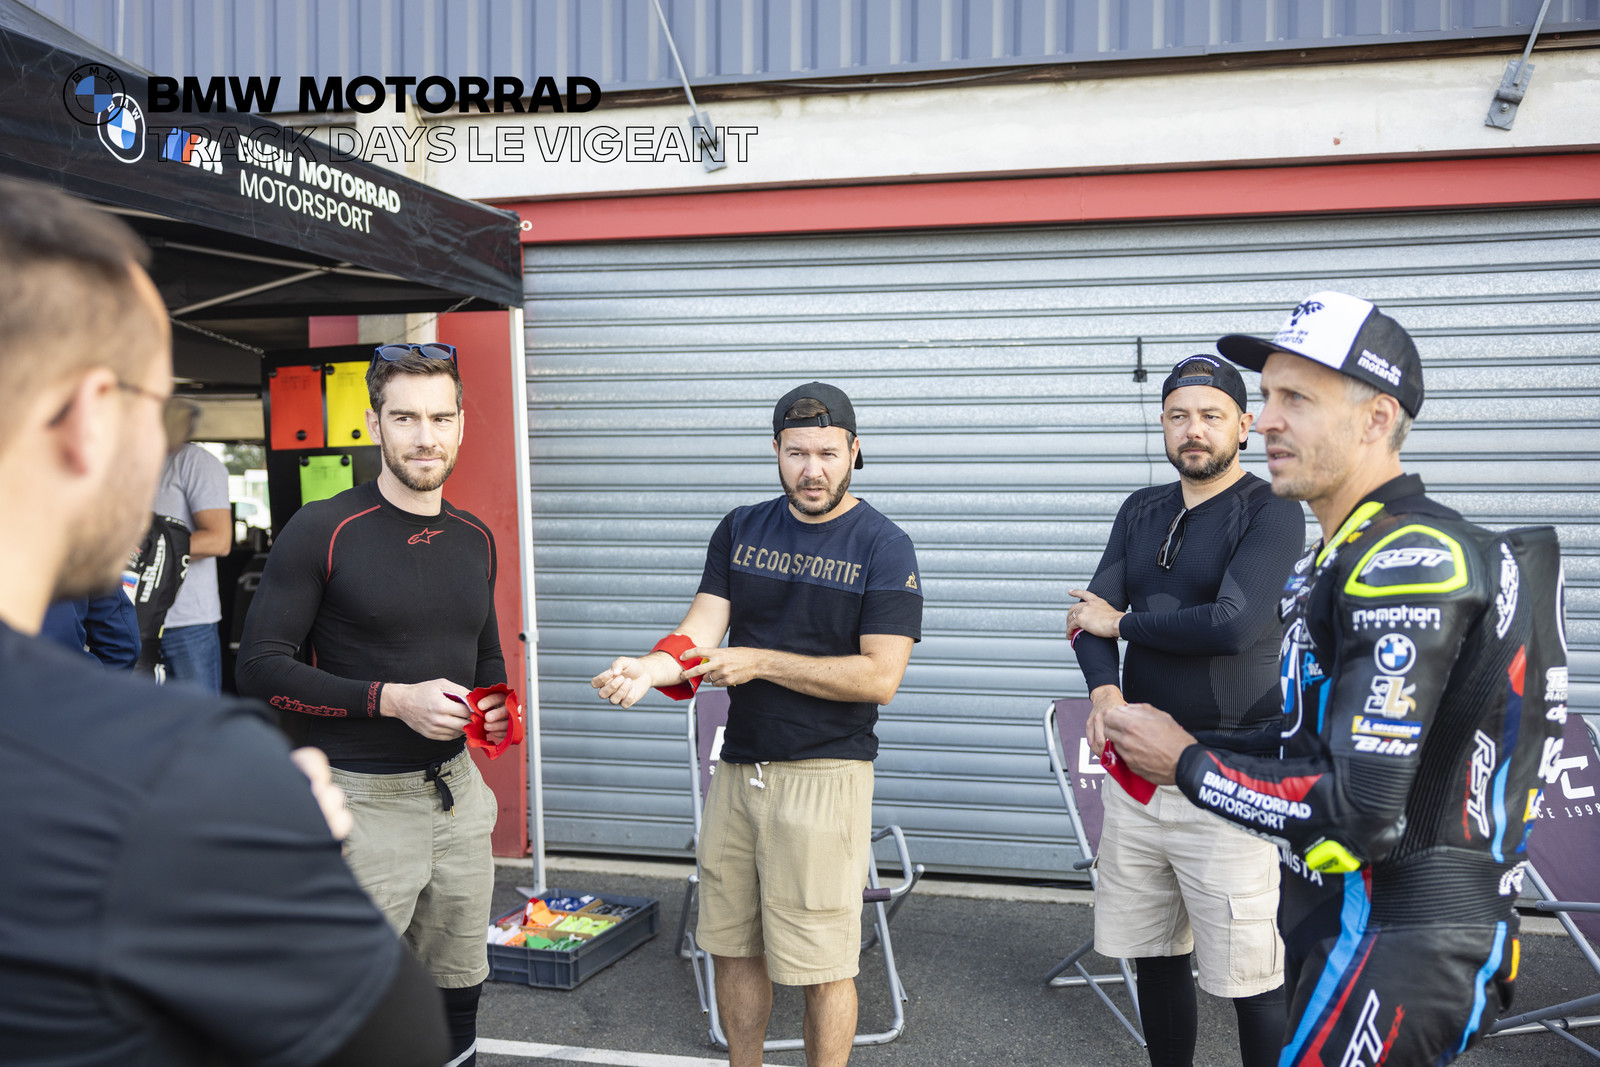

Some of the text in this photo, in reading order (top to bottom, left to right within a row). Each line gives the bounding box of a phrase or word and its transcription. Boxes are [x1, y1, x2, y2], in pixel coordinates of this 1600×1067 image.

[238, 134, 293, 177] BMW
[299, 156, 401, 214] MOTORRAD
[240, 169, 373, 234] MOTORSPORT
[1357, 356, 1400, 387] motards
[732, 543, 862, 585] LE COQ SPORTIF
[1351, 734, 1419, 756] Bihr
[1198, 785, 1287, 831] MOTORSPORT
[1202, 770, 1313, 819] BMW MOTORRAD
